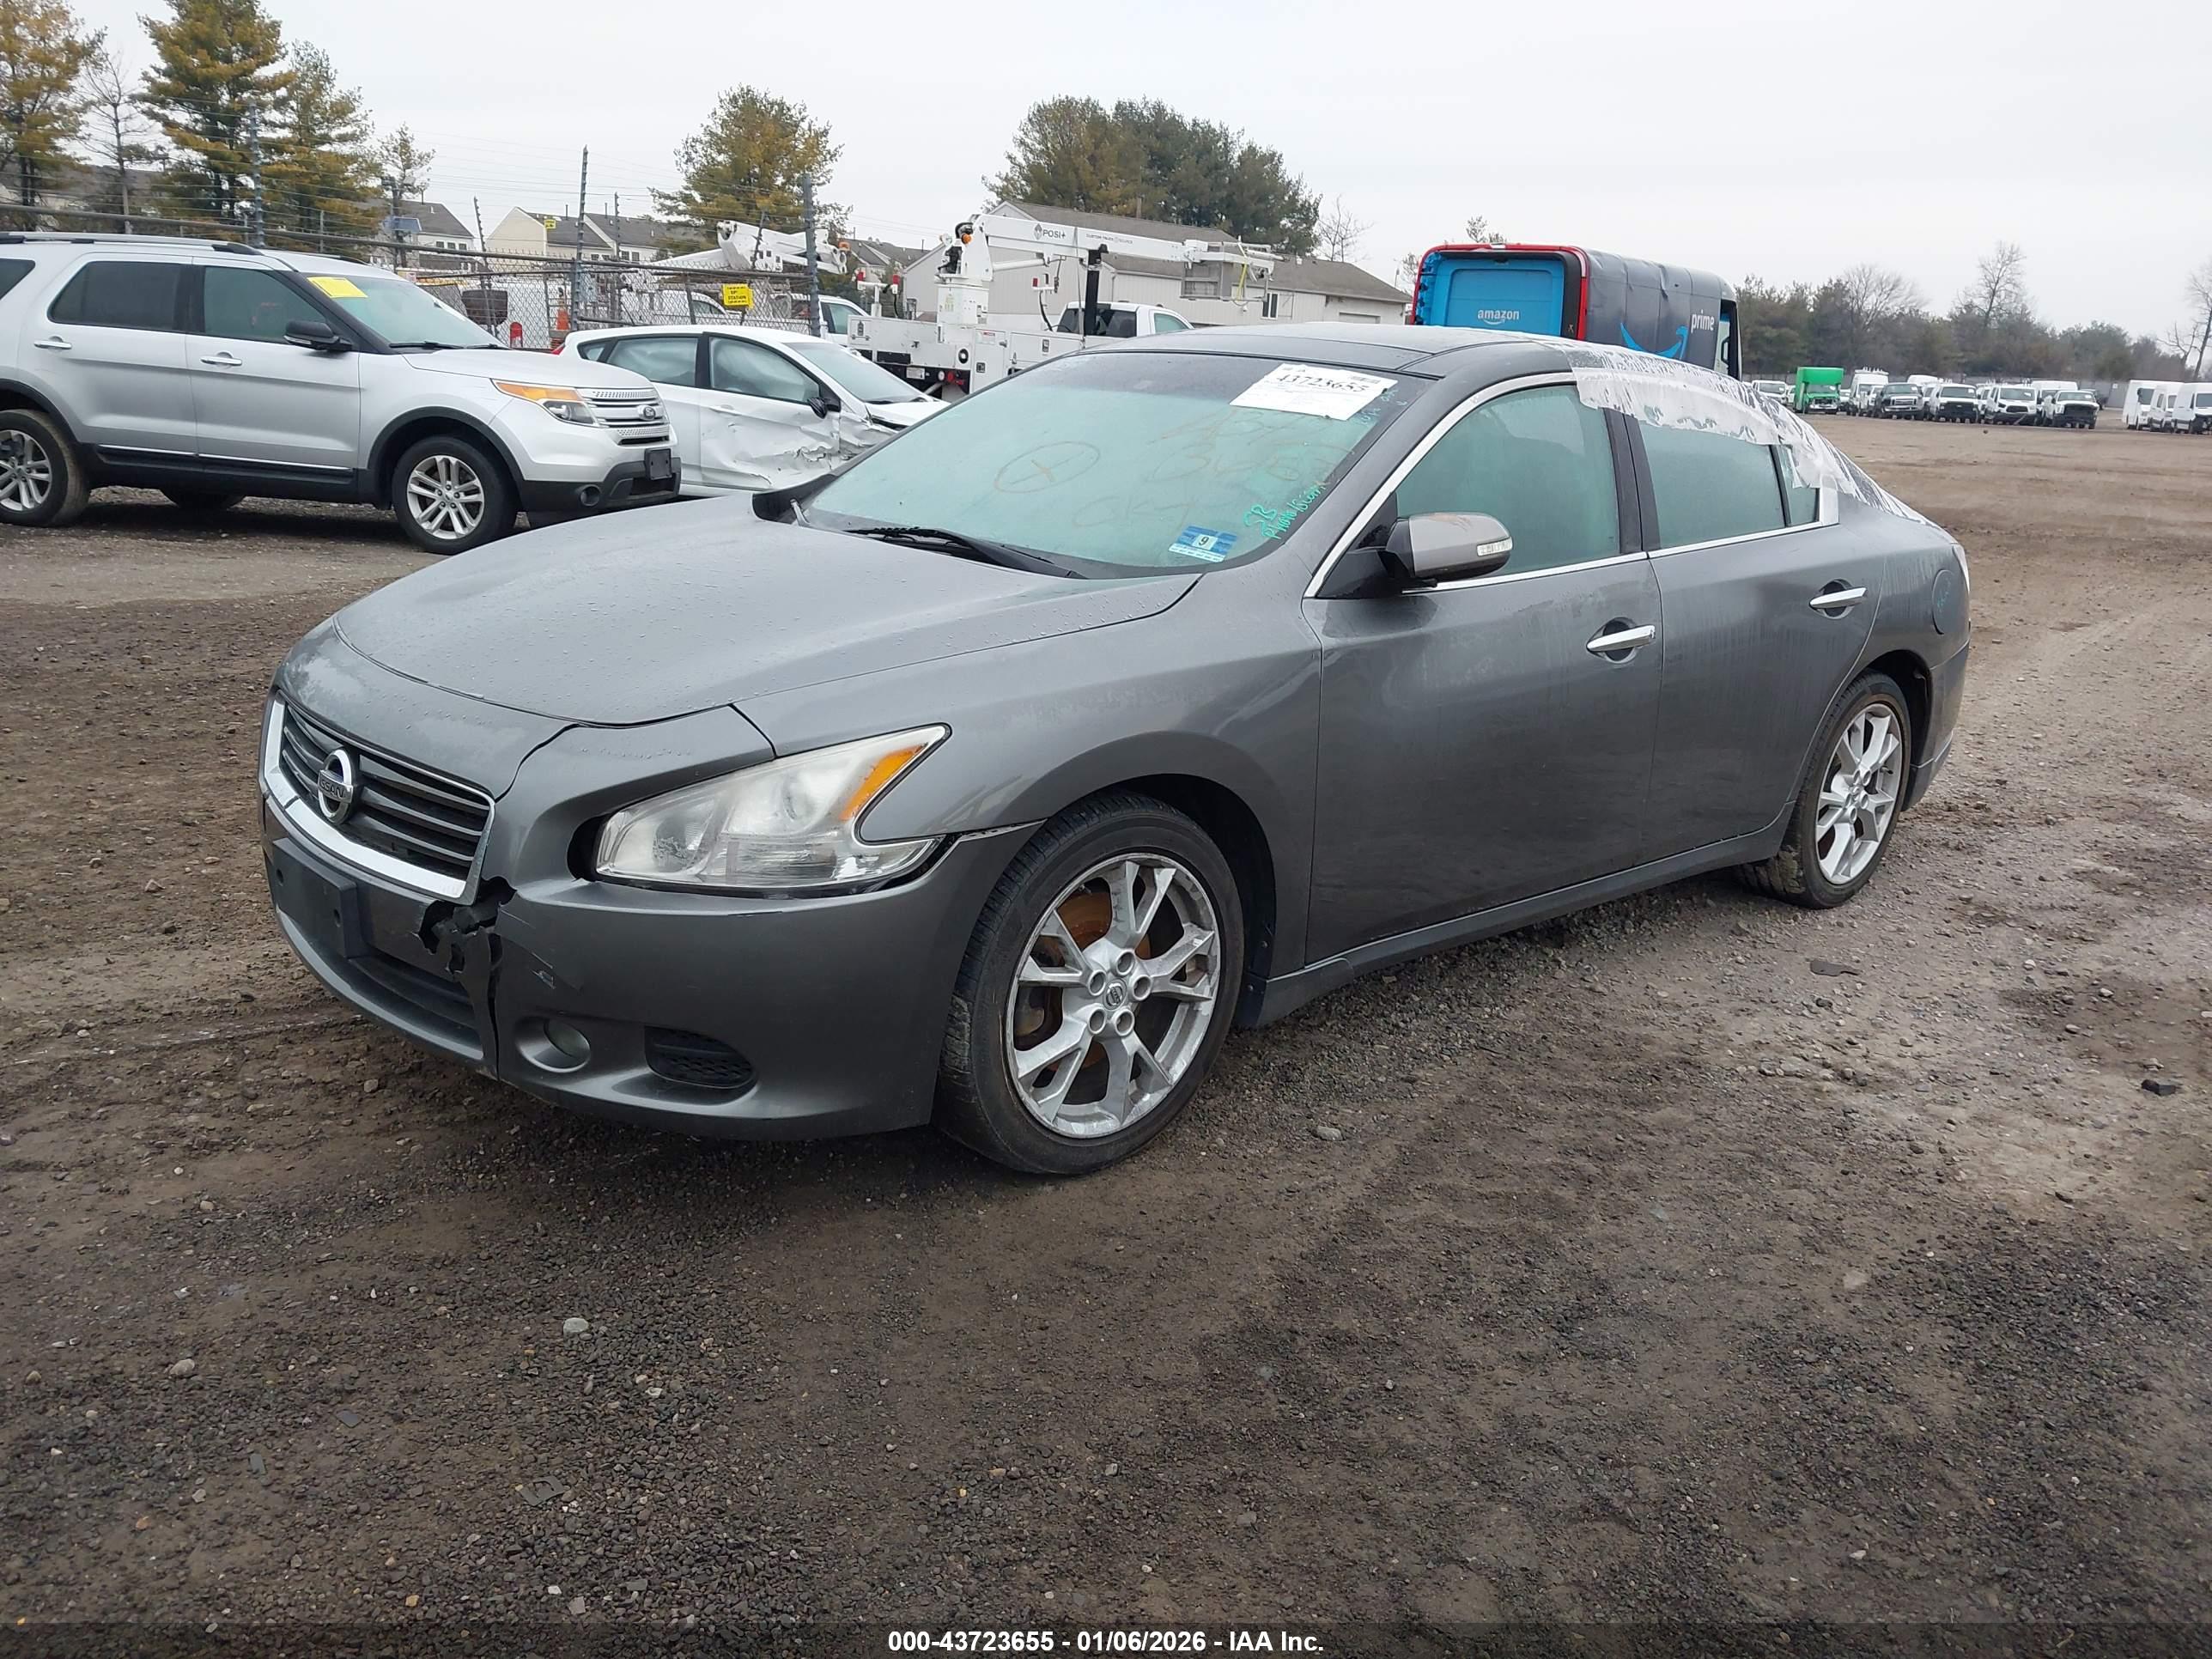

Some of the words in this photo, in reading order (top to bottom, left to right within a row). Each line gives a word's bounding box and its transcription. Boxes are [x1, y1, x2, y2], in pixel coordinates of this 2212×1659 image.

[1477, 309, 1520, 320] amazon
[1690, 308, 1715, 334] prime
[1276, 374, 1371, 392] 43723655
[1198, 535, 1211, 547] 9
[319, 778, 344, 799] SSAN
